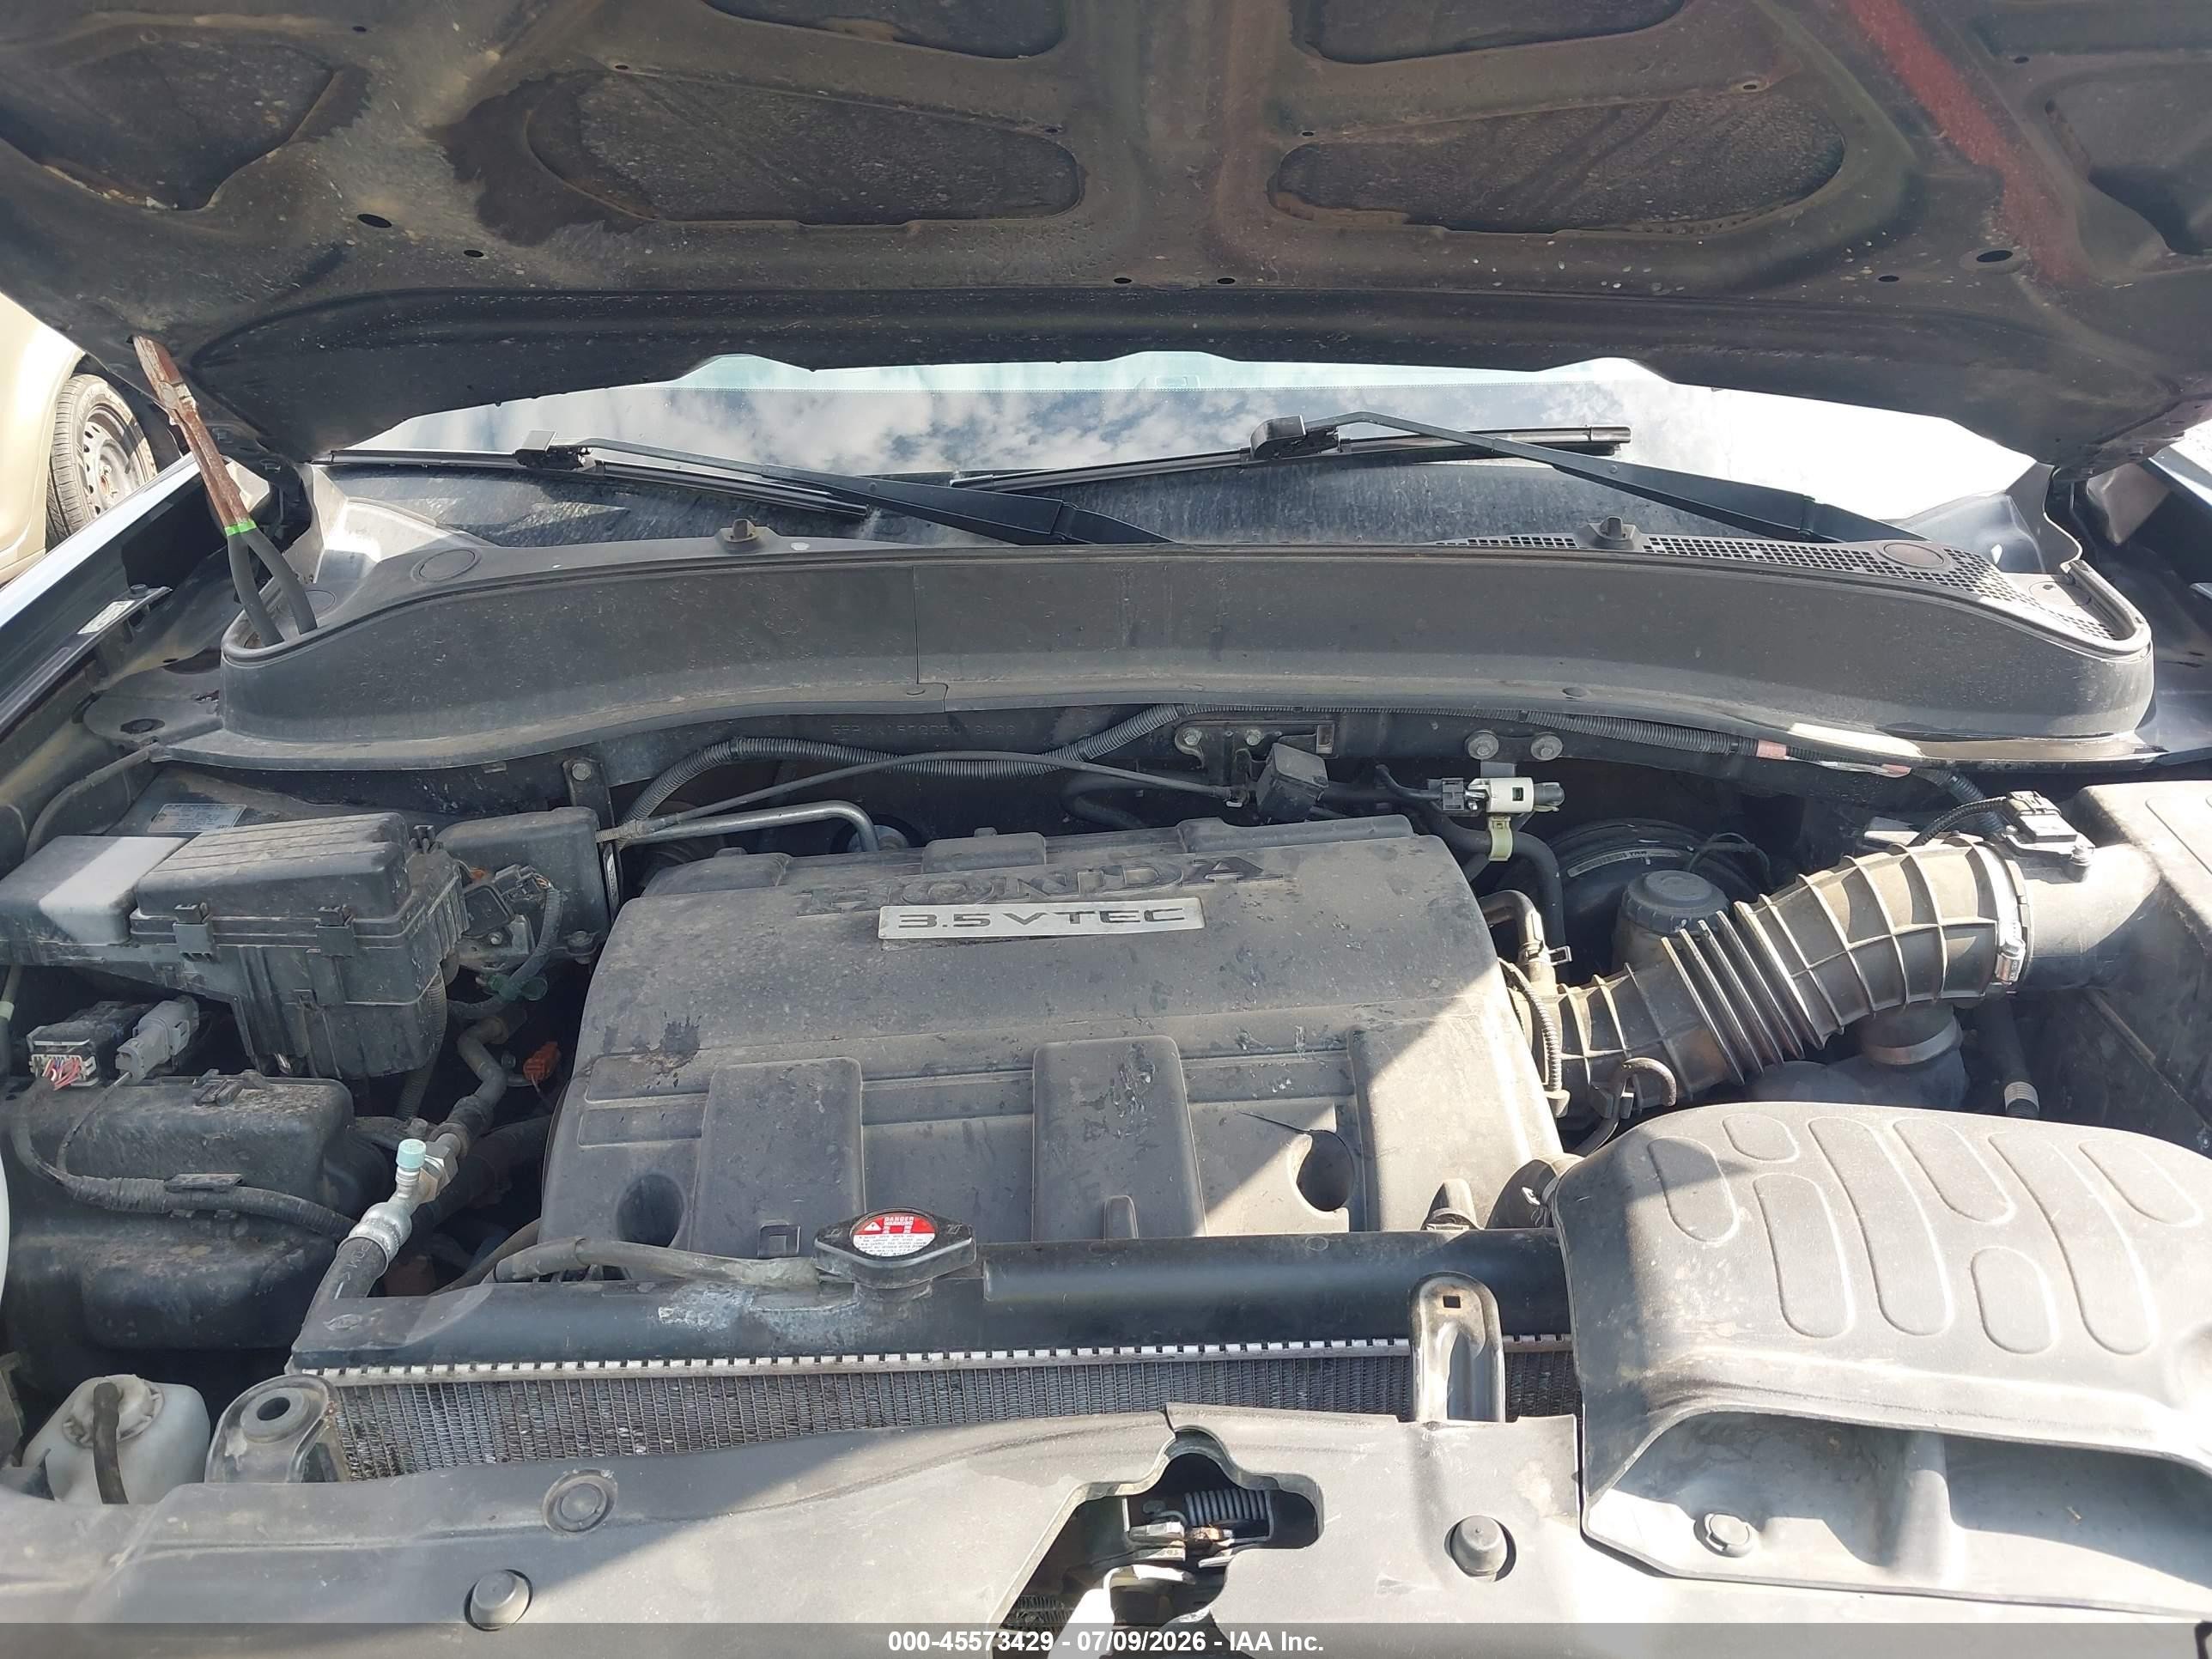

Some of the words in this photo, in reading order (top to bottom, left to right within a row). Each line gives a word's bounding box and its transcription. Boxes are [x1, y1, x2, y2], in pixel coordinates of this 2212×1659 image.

[797, 856, 1284, 916] HONDA
[898, 912, 991, 929] 3.5
[1002, 908, 1186, 926] VTEC
